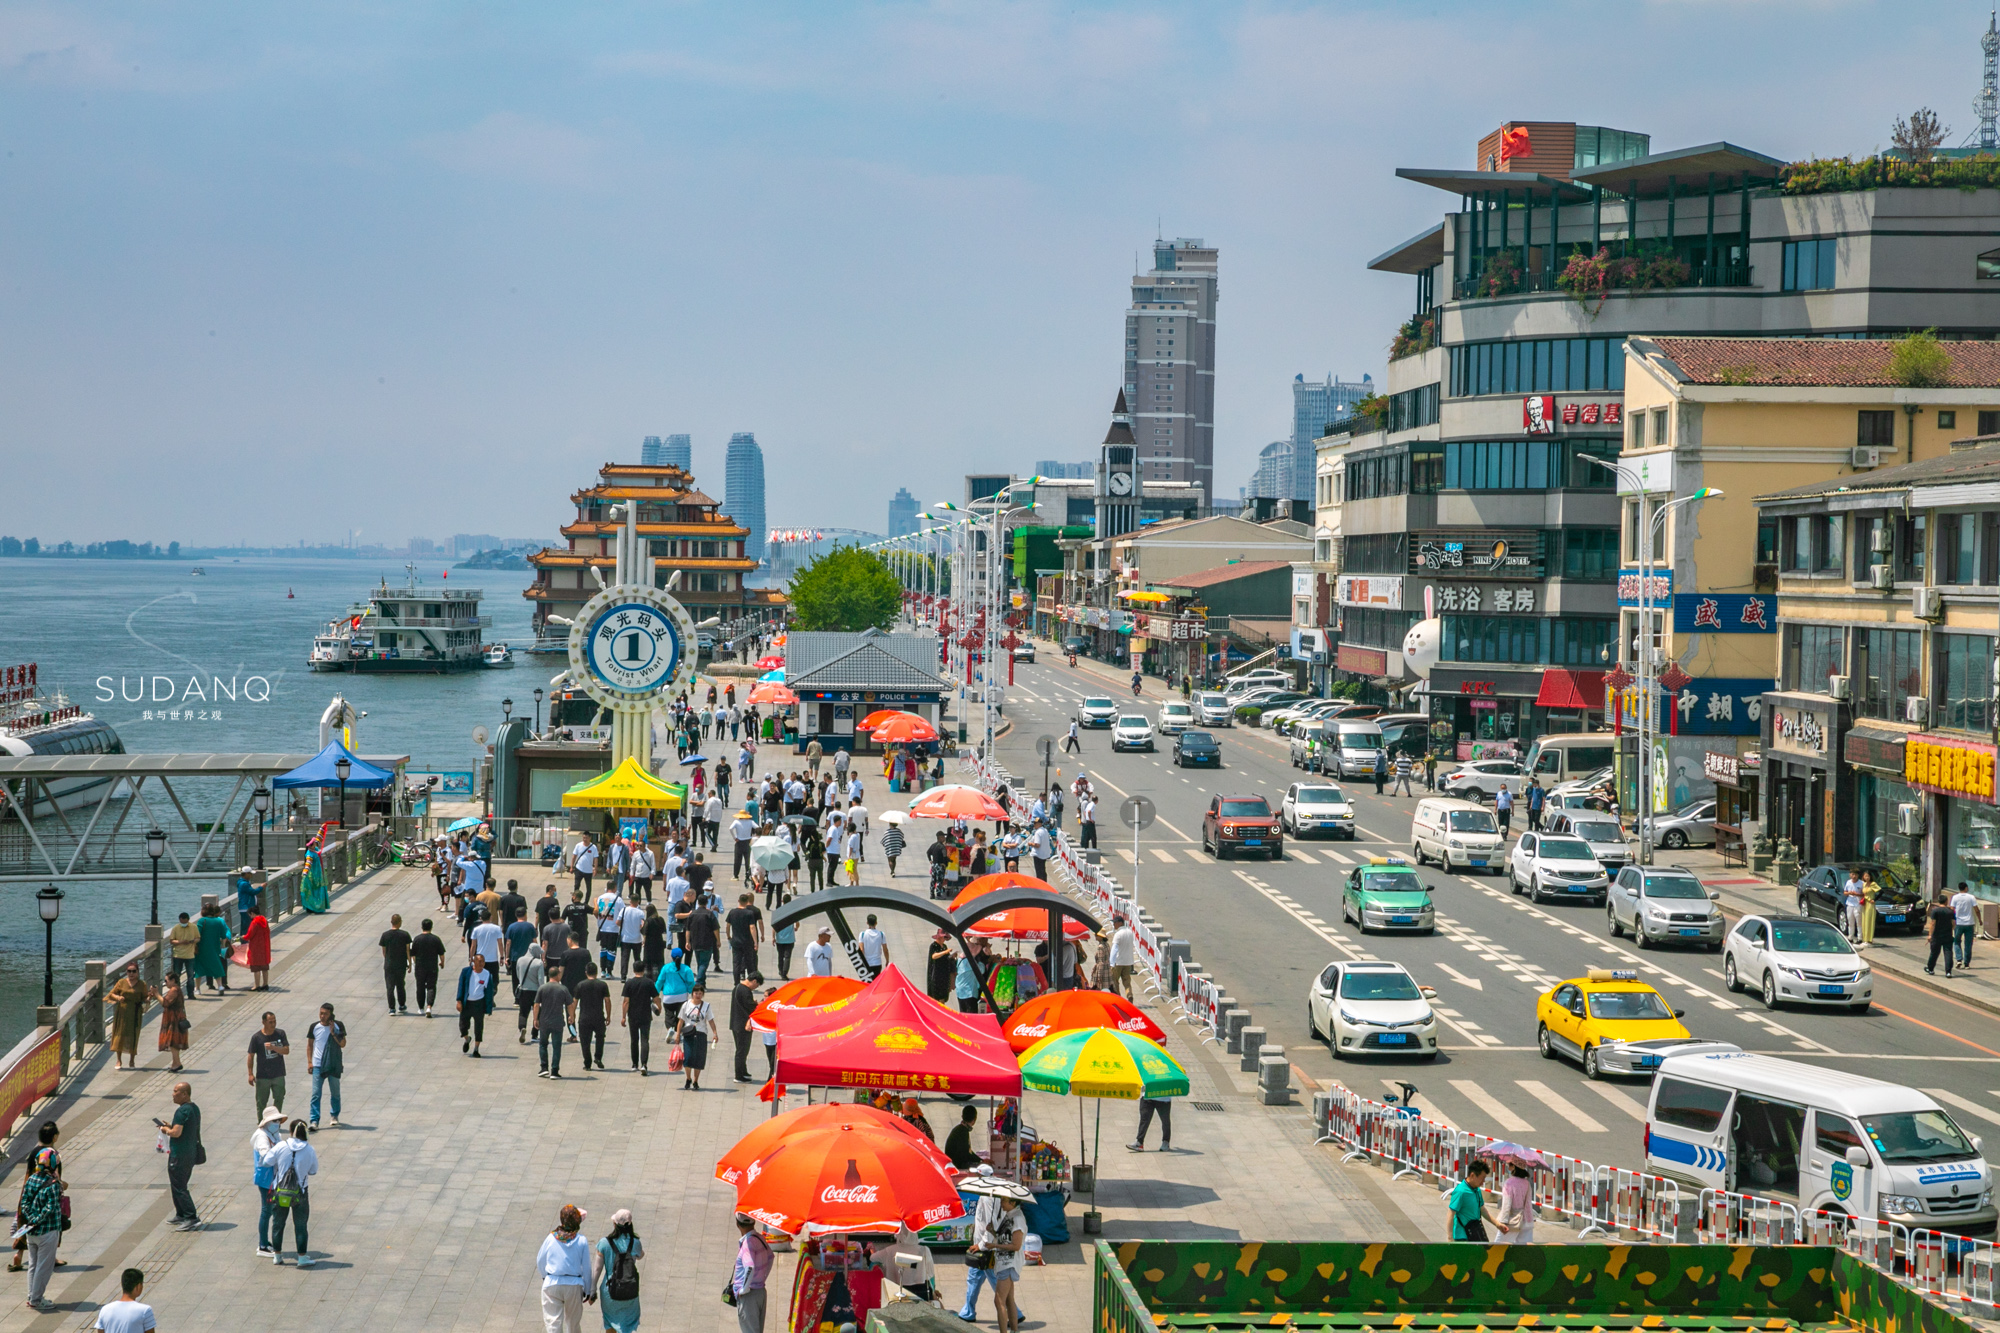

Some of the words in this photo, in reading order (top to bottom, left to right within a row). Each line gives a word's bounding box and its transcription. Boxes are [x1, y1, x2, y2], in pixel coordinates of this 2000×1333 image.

[1562, 402, 1622, 425] 肯德基
[1445, 542, 1463, 552] spa
[1473, 556, 1492, 565] NINE
[1505, 556, 1530, 565] HOTEL
[1437, 586, 1481, 611] 洗浴
[1494, 587, 1535, 612] 客房
[599, 612, 667, 642] 观光码头
[1172, 621, 1205, 640] 超市
[620, 632, 647, 661] 1
[604, 657, 634, 679] Tourist
[639, 656, 664, 678] Wharf
[841, 692, 860, 701] 公安
[1460, 681, 1496, 696] KFC
[1012, 1023, 1052, 1038] Coca-Cola
[1915, 1163, 1977, 1175] 城市管理执法
[821, 1184, 879, 1204] Coca-Cola
[748, 1208, 789, 1228] Coca-Cola
[923, 1204, 953, 1223] 可口可乐
